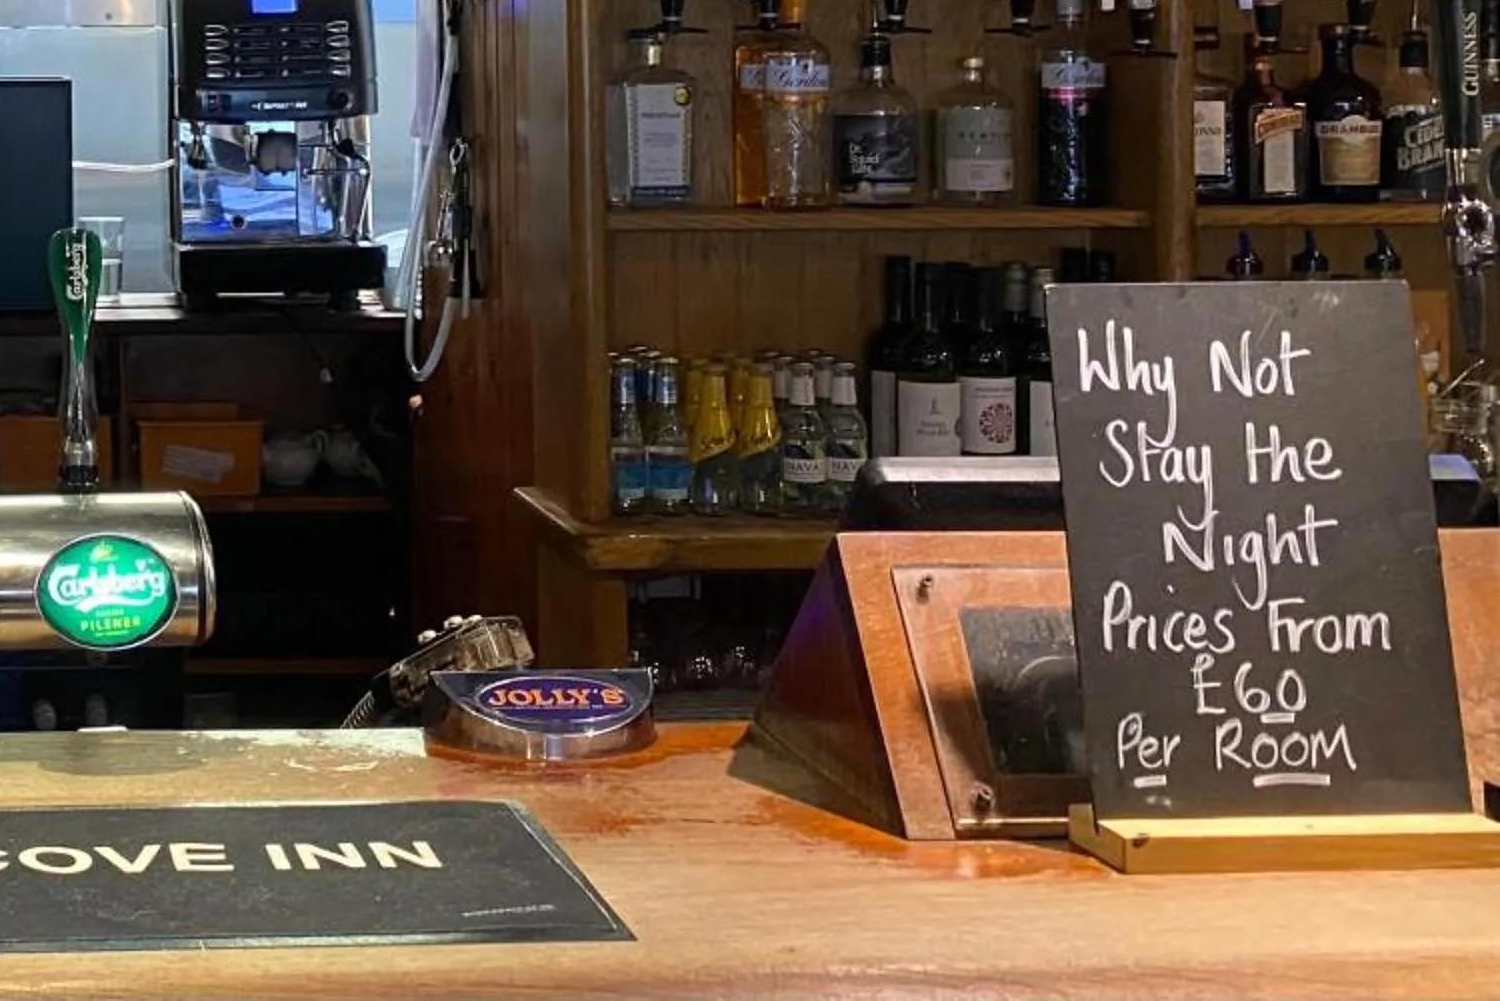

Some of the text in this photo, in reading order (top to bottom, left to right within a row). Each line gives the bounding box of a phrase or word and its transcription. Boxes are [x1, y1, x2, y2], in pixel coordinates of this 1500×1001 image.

[1460, 10, 1481, 97] GUINNESS
[66, 242, 90, 301] Carlsberg
[1077, 319, 1312, 449] Why Not
[1099, 418, 1344, 531] Stay the
[48, 561, 167, 613] Carlsberg
[1162, 503, 1339, 611] Night
[1102, 579, 1392, 655] Prices From
[487, 686, 625, 706] JOLLY'S
[1191, 653, 1307, 714] £60
[1116, 712, 1181, 772] Per
[266, 840, 444, 871] INN
